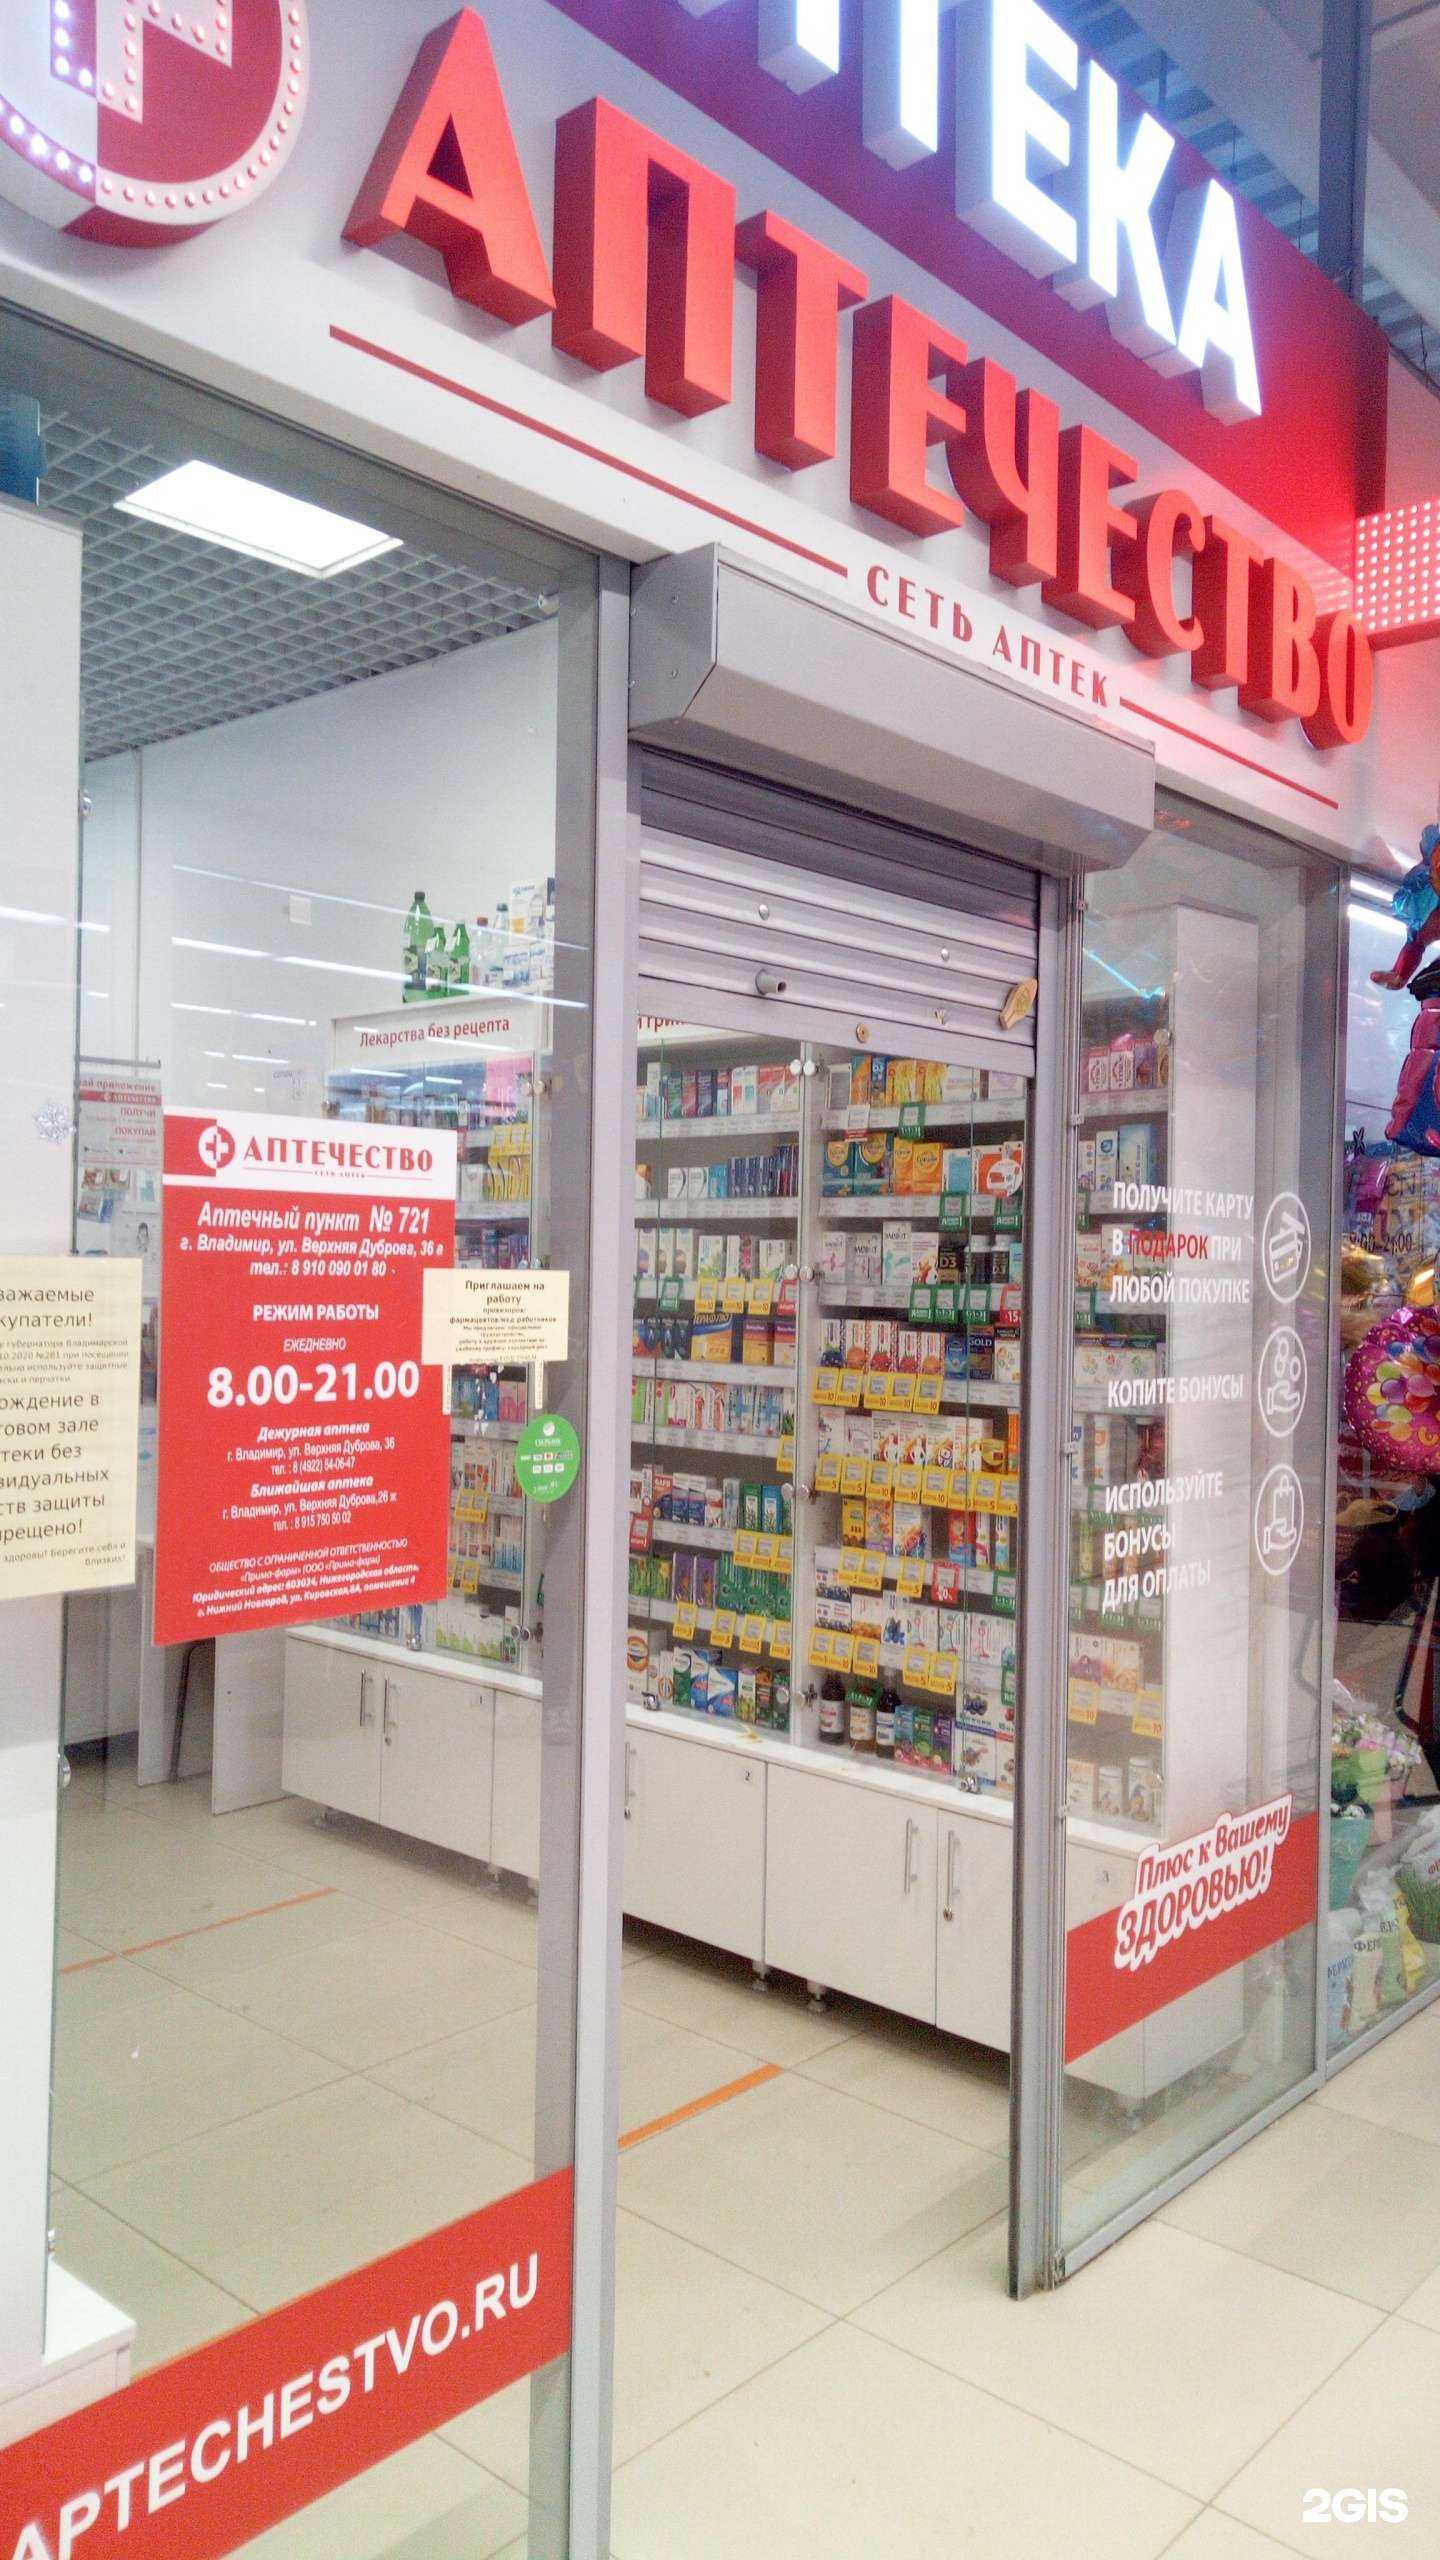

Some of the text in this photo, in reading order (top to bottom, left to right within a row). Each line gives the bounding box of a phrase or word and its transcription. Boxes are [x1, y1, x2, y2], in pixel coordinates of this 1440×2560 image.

[342, 5, 1374, 750] АПТЕЧЕСТВО
[867, 565, 1108, 708] СЕТЬ АПТЕК
[360, 1018, 510, 1048] Лекарства без рецепта
[244, 1136, 433, 1172] АПТЕЧЕСТВО
[1113, 1181, 1254, 1221] ПОЛУЧИТЕ КАРТУ
[197, 1201, 429, 1235] Аптечный пункт № 721
[197, 1234, 273, 1254] Владимир,
[278, 1240, 297, 1255] ул.
[302, 1238, 356, 1255] Верхняя
[359, 1239, 417, 1257] Дуброва,
[420, 1240, 434, 1255] 36
[1112, 1228, 1242, 1263] В ПОДАРОК ПРИ
[291, 1260, 299, 1275] 8
[302, 1260, 325, 1276] 910
[328, 1260, 351, 1276] 090
[354, 1260, 368, 1276] 01
[372, 1260, 386, 1276] 80
[465, 1280, 545, 1293] Приглашаем на
[486, 1294, 521, 1306] работу
[1110, 1271, 1250, 1305] ЛЮБОЙ ПОКУПКЕ
[253, 1304, 379, 1321] РЕЖИМ РАБОТЫ
[283, 1338, 346, 1352] ЕЖЕДНЕВНО
[207, 1360, 419, 1408] 8.00-21.00
[1108, 1374, 1244, 1408] КОПИТЕ БОНУСЫ
[90, 1394, 99, 1406] в
[57, 1418, 99, 1433] зале
[257, 1422, 370, 1443] Дежурная аптека
[51, 1443, 82, 1460] без
[236, 1447, 285, 1463] Владимир,
[251, 1475, 373, 1498] Ближайшая аптека
[1105, 1469, 1223, 1514] ИСПОЛЬЗУЙТЕ
[33, 1494, 105, 1514] защиты
[231, 1504, 281, 1520] Владимир,
[209, 1556, 256, 1574] ОБЩЕСТВО
[264, 1545, 329, 1566] ОГРАНИЧЕННОЙ
[330, 1538, 408, 1558] ОТВЕТСТВЕННОСТЬЮ
[1104, 1522, 1176, 1561] БОНУСЫ
[192, 1585, 256, 1604] Юридический
[1102, 1559, 1211, 1615] ДЛЯ ОПЛАТЫ
[206, 1601, 242, 1615] Нижний
[1138, 1805, 1290, 1894] Плюс к Вашему
[1118, 1844, 1270, 1958] ЗДОРОВЬЮ!
[11, 2253, 538, 2560] APTECHESTVO.RU
